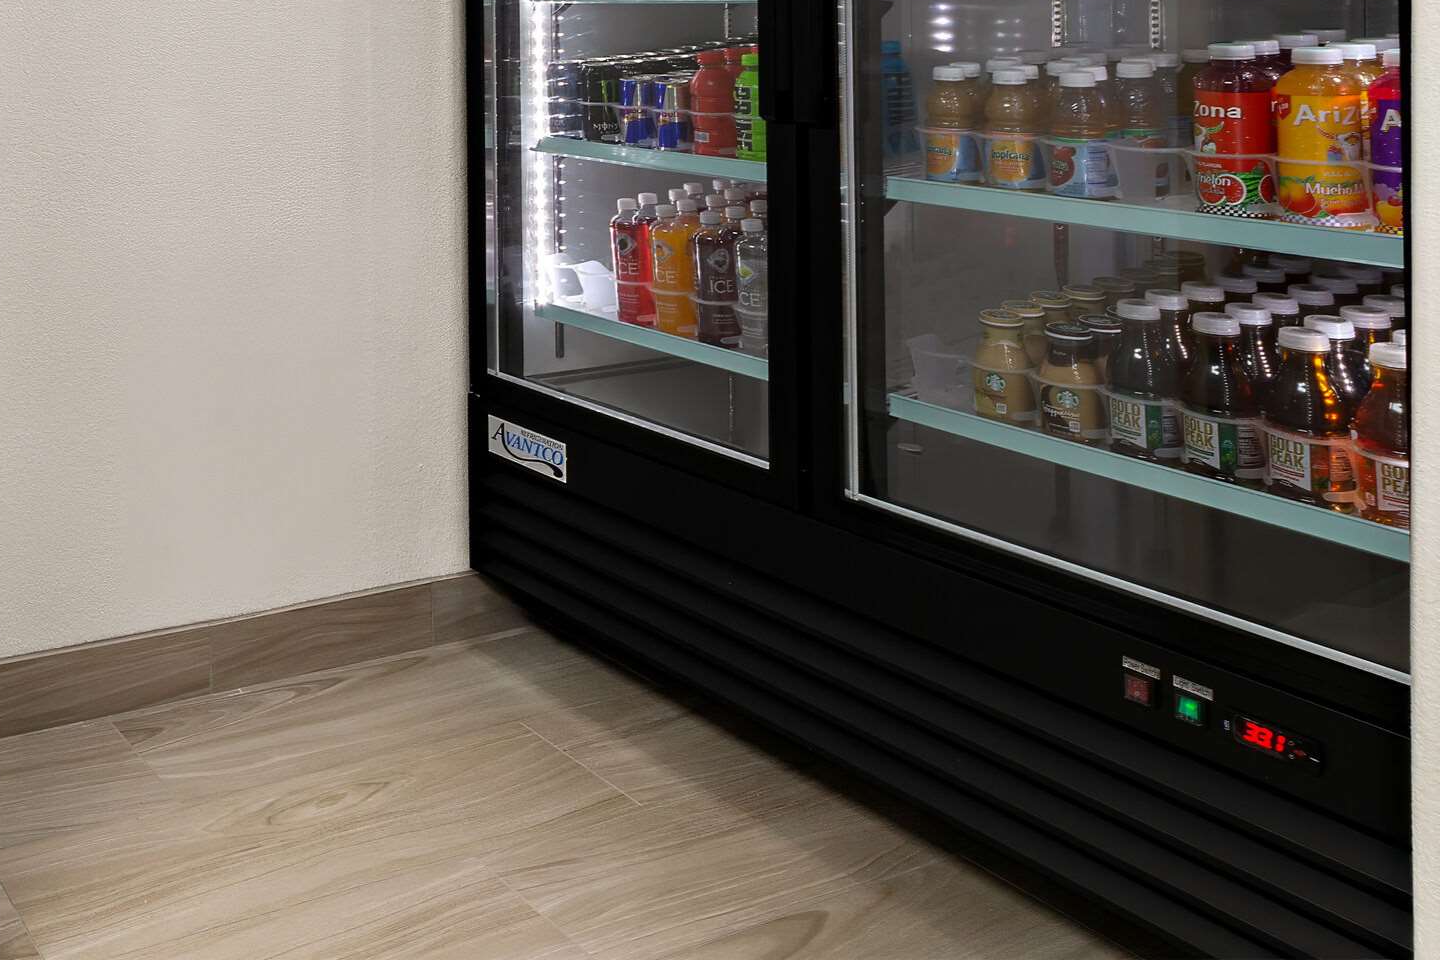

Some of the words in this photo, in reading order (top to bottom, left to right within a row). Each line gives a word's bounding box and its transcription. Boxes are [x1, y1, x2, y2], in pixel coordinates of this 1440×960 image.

[1193, 100, 1242, 119] Zona
[619, 261, 639, 275] CE
[656, 270, 676, 284] CE
[710, 279, 735, 294] ICE
[740, 291, 761, 307] CE
[491, 422, 564, 466] AVANTCO
[1270, 434, 1304, 459] GOLD
[1382, 463, 1409, 480] GOL
[1382, 477, 1409, 495] PEA
